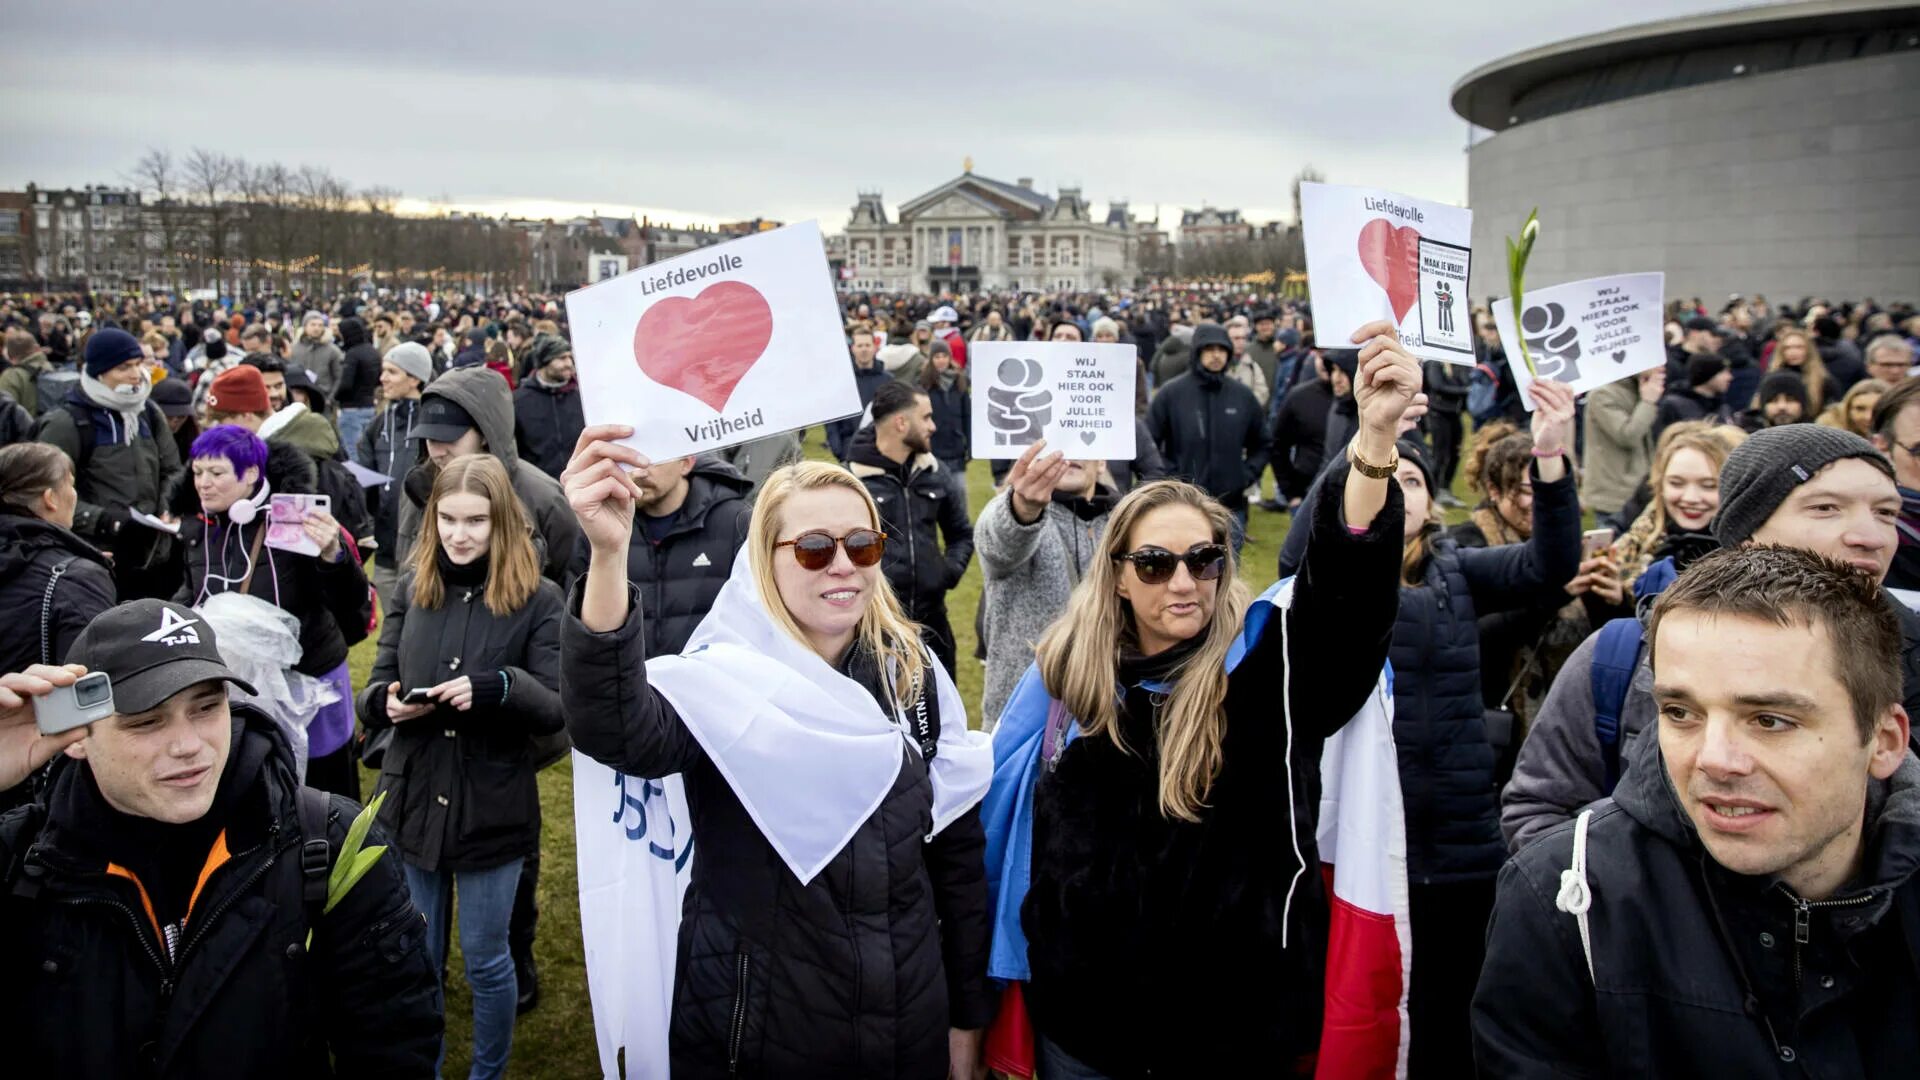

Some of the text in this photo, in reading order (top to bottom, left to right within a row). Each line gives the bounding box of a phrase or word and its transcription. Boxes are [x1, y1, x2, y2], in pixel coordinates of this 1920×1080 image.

[1364, 196, 1424, 223] Liefdevolle
[641, 254, 744, 296] Liefdevolle
[1597, 287, 1621, 297] WIJ
[1589, 295, 1631, 309] STAAN
[1581, 303, 1640, 322] HIER OOK
[1594, 316, 1628, 330] VOOR
[1593, 326, 1633, 343] JULLIE
[1589, 335, 1641, 356] VRIJHEID
[1075, 358, 1097, 367] WIJ
[1067, 370, 1105, 379] STAAN
[1058, 382, 1114, 392] HIER OOK
[1070, 395, 1101, 404] VOOR
[1066, 407, 1105, 416] JULLIE
[685, 408, 764, 443] Vrijheid
[1059, 420, 1113, 429] VRIJHEID
